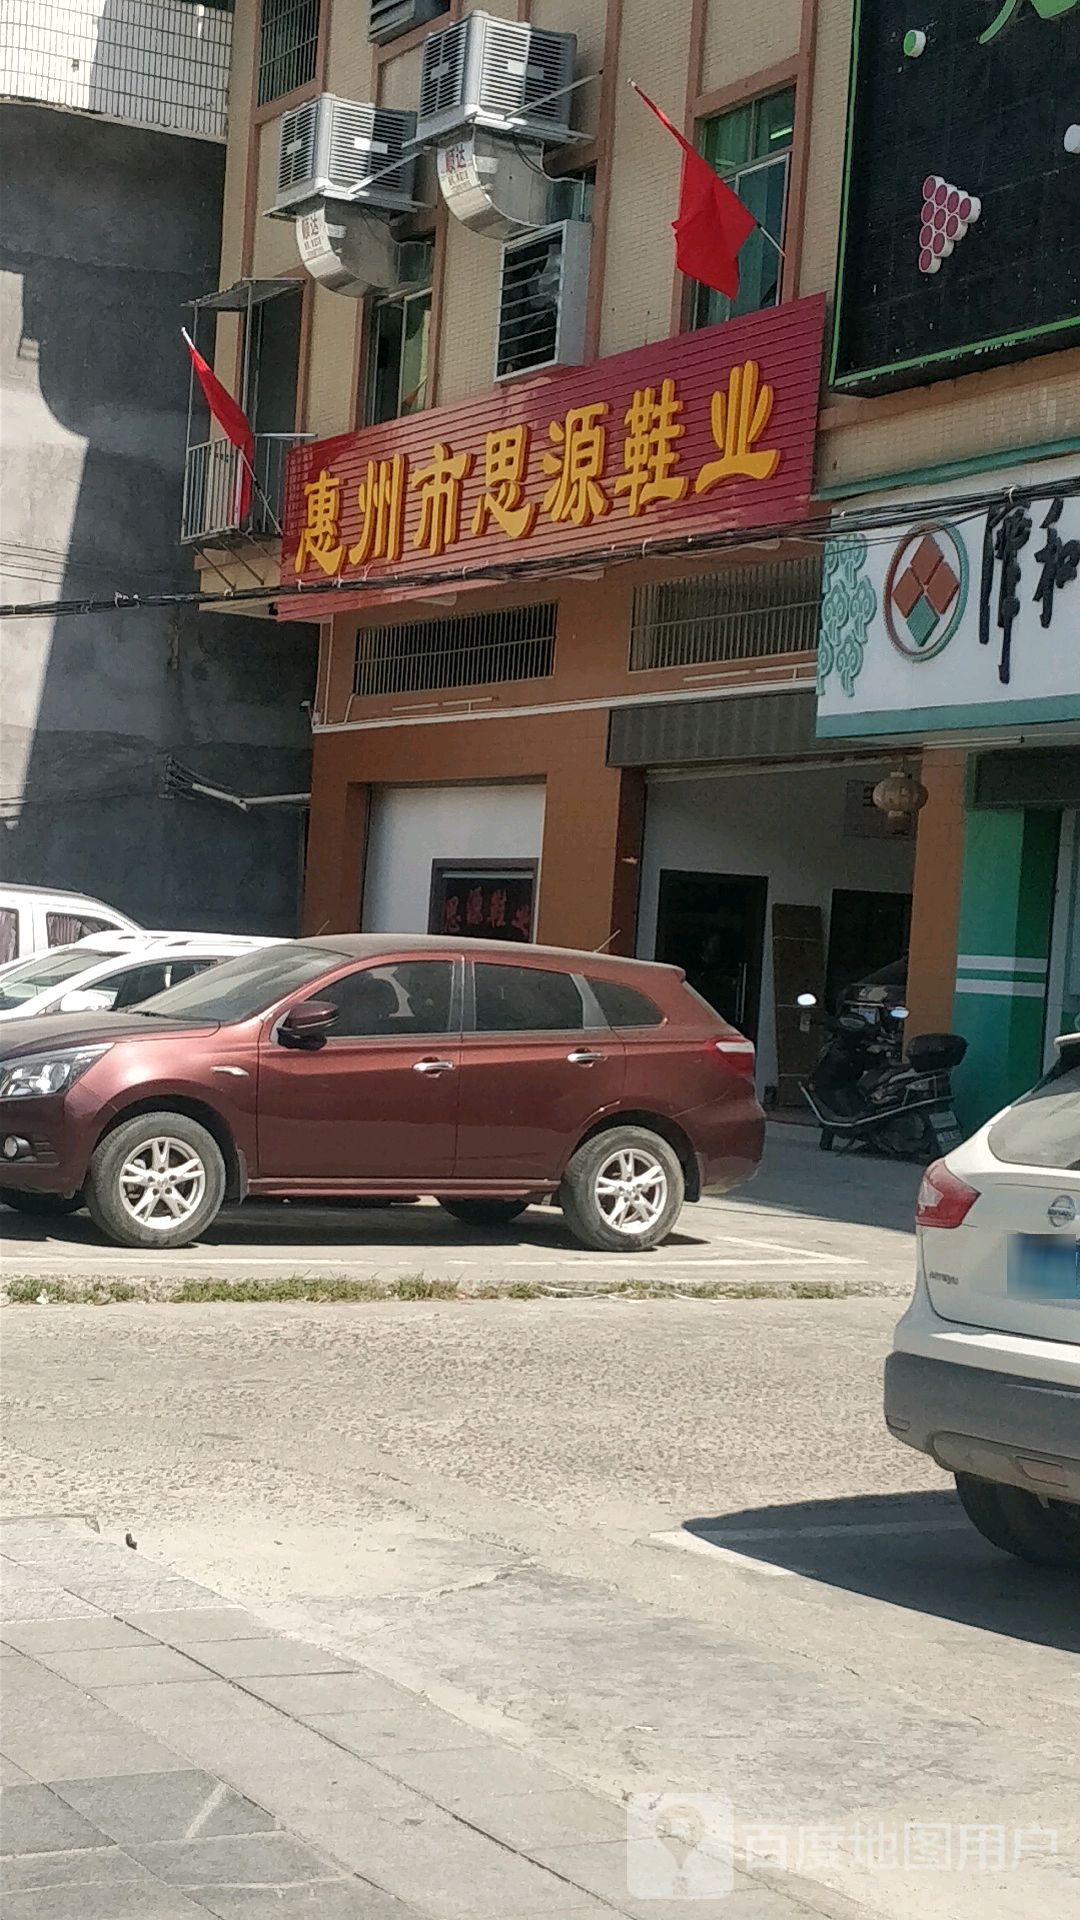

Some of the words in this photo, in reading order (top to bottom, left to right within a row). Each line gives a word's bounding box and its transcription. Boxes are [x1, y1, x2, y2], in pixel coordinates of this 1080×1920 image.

[294, 359, 781, 577] 惠州市思源鞋业
